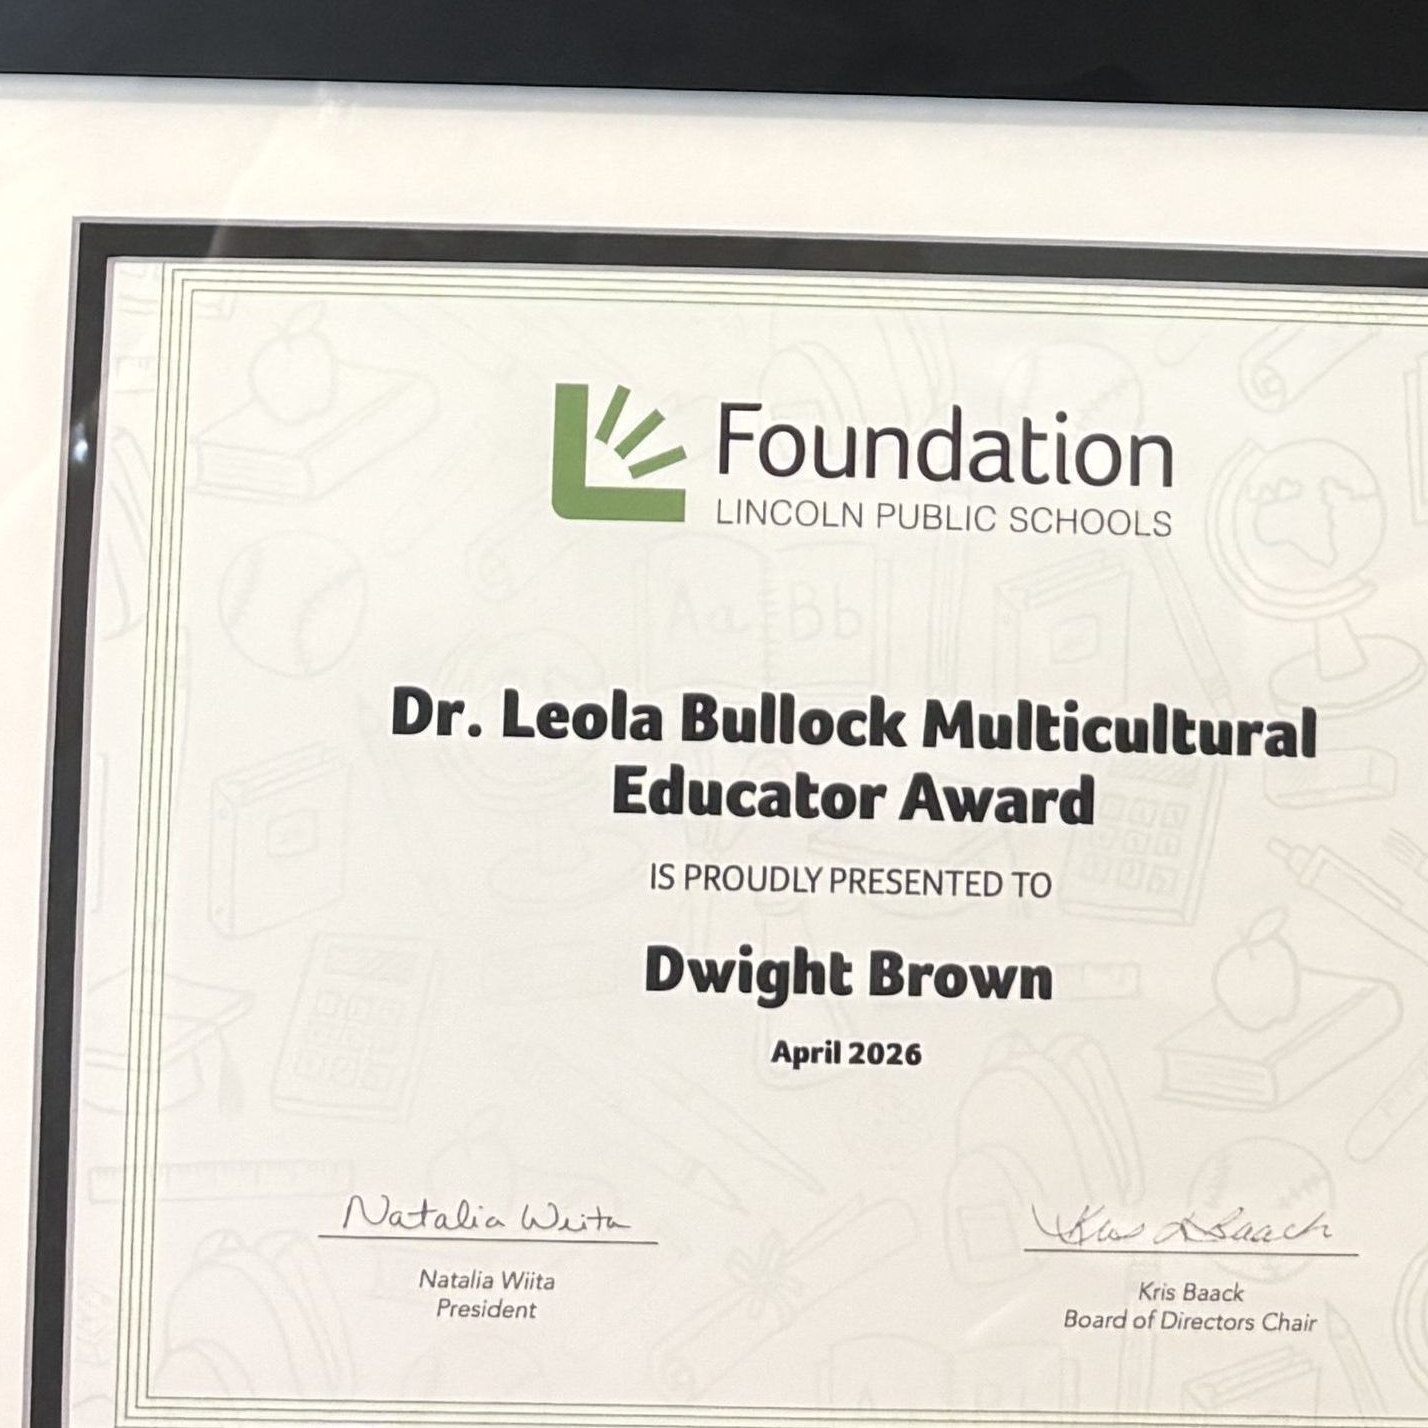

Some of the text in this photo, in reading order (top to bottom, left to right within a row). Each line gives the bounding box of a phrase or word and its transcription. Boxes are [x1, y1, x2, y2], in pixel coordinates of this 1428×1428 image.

[718, 402, 1174, 488] Foundation
[717, 498, 1172, 537] LINCOLN PUBLIC SCHOOLS
[392, 685, 1317, 759] Dr. Leola Bullock Multicultural
[612, 763, 1095, 826] Educator Award
[650, 862, 1052, 899] IS PROUDLY PRESENTED TO
[645, 943, 1053, 1010] Dwight Brown
[770, 1039, 922, 1071] April 2026
[342, 1194, 505, 1230] Natalia
[418, 1269, 556, 1291] Natalia Wiita
[1137, 1281, 1245, 1303] Kris Baack
[436, 1298, 538, 1320] President
[1063, 1309, 1319, 1333] Board of Directors Chair
